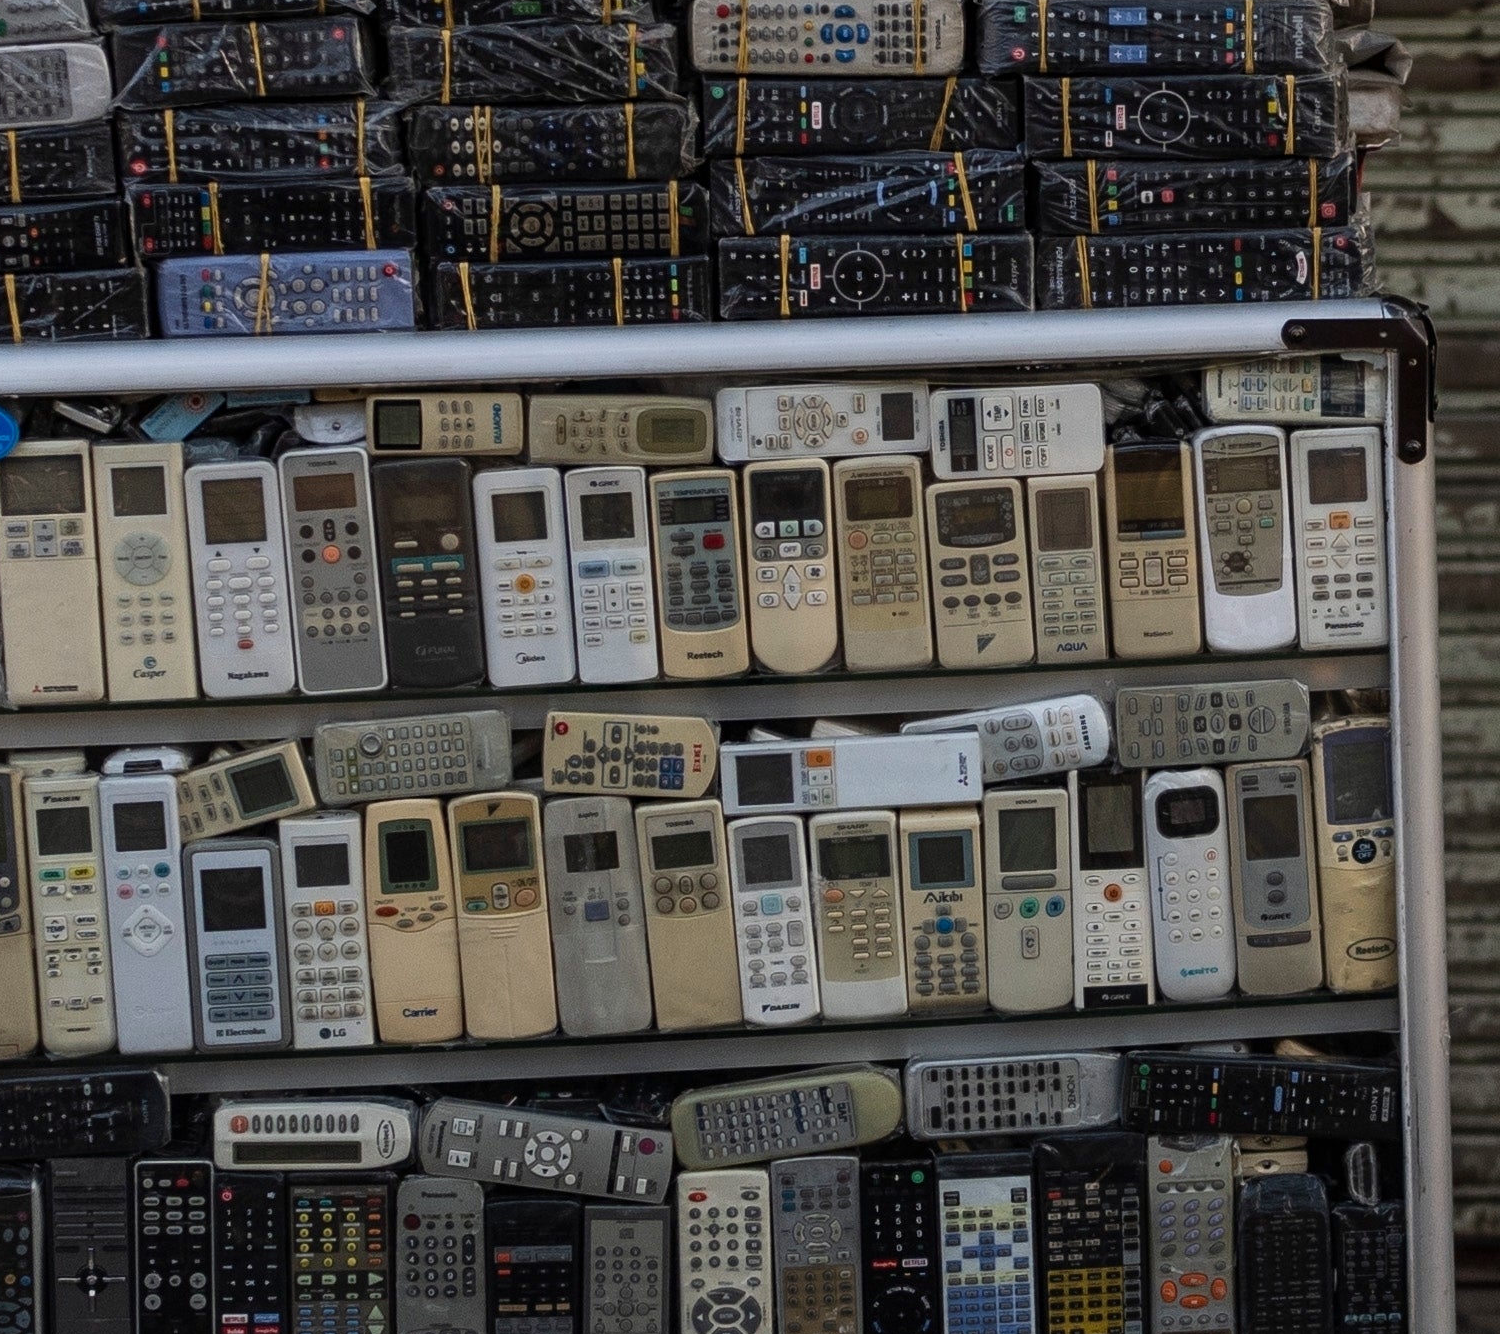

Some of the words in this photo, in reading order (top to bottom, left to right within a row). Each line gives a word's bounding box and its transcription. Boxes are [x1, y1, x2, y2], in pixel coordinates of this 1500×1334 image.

[1293, 16, 1305, 59] mobell
[1010, 257, 1020, 291] Casper
[493, 404, 503, 445] DIAMOND
[1324, 621, 1365, 630] Panasonic
[1057, 642, 1088, 652] AQUA
[520, 653, 546, 663] Midea
[133, 669, 166, 679] Casper
[227, 670, 269, 680] Nagakawa
[1078, 714, 1092, 751] SAMSUNG
[693, 744, 702, 773] EIKI
[665, 819, 694, 828] TOSHIBA
[836, 823, 869, 831] SHARP
[1359, 843, 1371, 851] ON
[1357, 851, 1372, 859] OFF
[44, 870, 61, 878] COOL
[75, 869, 89, 877] OFF
[923, 892, 963, 904] Aikibi
[1269, 912, 1292, 921] GREE
[46, 925, 65, 934] TEMP
[769, 1003, 800, 1012] DAIKIN
[402, 1007, 439, 1018] Carrier
[225, 1028, 266, 1037] Electrolux
[333, 1028, 347, 1037] LG
[1067, 1074, 1076, 1109] DENON
[1370, 1086, 1379, 1122] SONY
[837, 1102, 848, 1123] JVC
[436, 1120, 448, 1159] Panasonic
[421, 1191, 458, 1199] Panasonic
[875, 1204, 880, 1213] 1
[895, 1203, 901, 1212] 2
[915, 1203, 922, 1211] 3
[874, 1218, 881, 1226] 4
[896, 1217, 901, 1225] 5
[916, 1216, 922, 1225] 6
[875, 1231, 882, 1239] 7
[896, 1230, 902, 1239] 8
[916, 1229, 923, 1238] 9
[410, 1239, 415, 1247] 1
[428, 1239, 435, 1247] 2
[447, 1239, 454, 1247] 3
[896, 1243, 903, 1252] 0
[408, 1256, 416, 1264] 4
[428, 1256, 435, 1264] 5
[447, 1256, 454, 1264] 6
[410, 1272, 416, 1280] 7
[428, 1272, 435, 1280] 8
[447, 1272, 454, 1280] 9
[428, 1288, 435, 1297] 0
